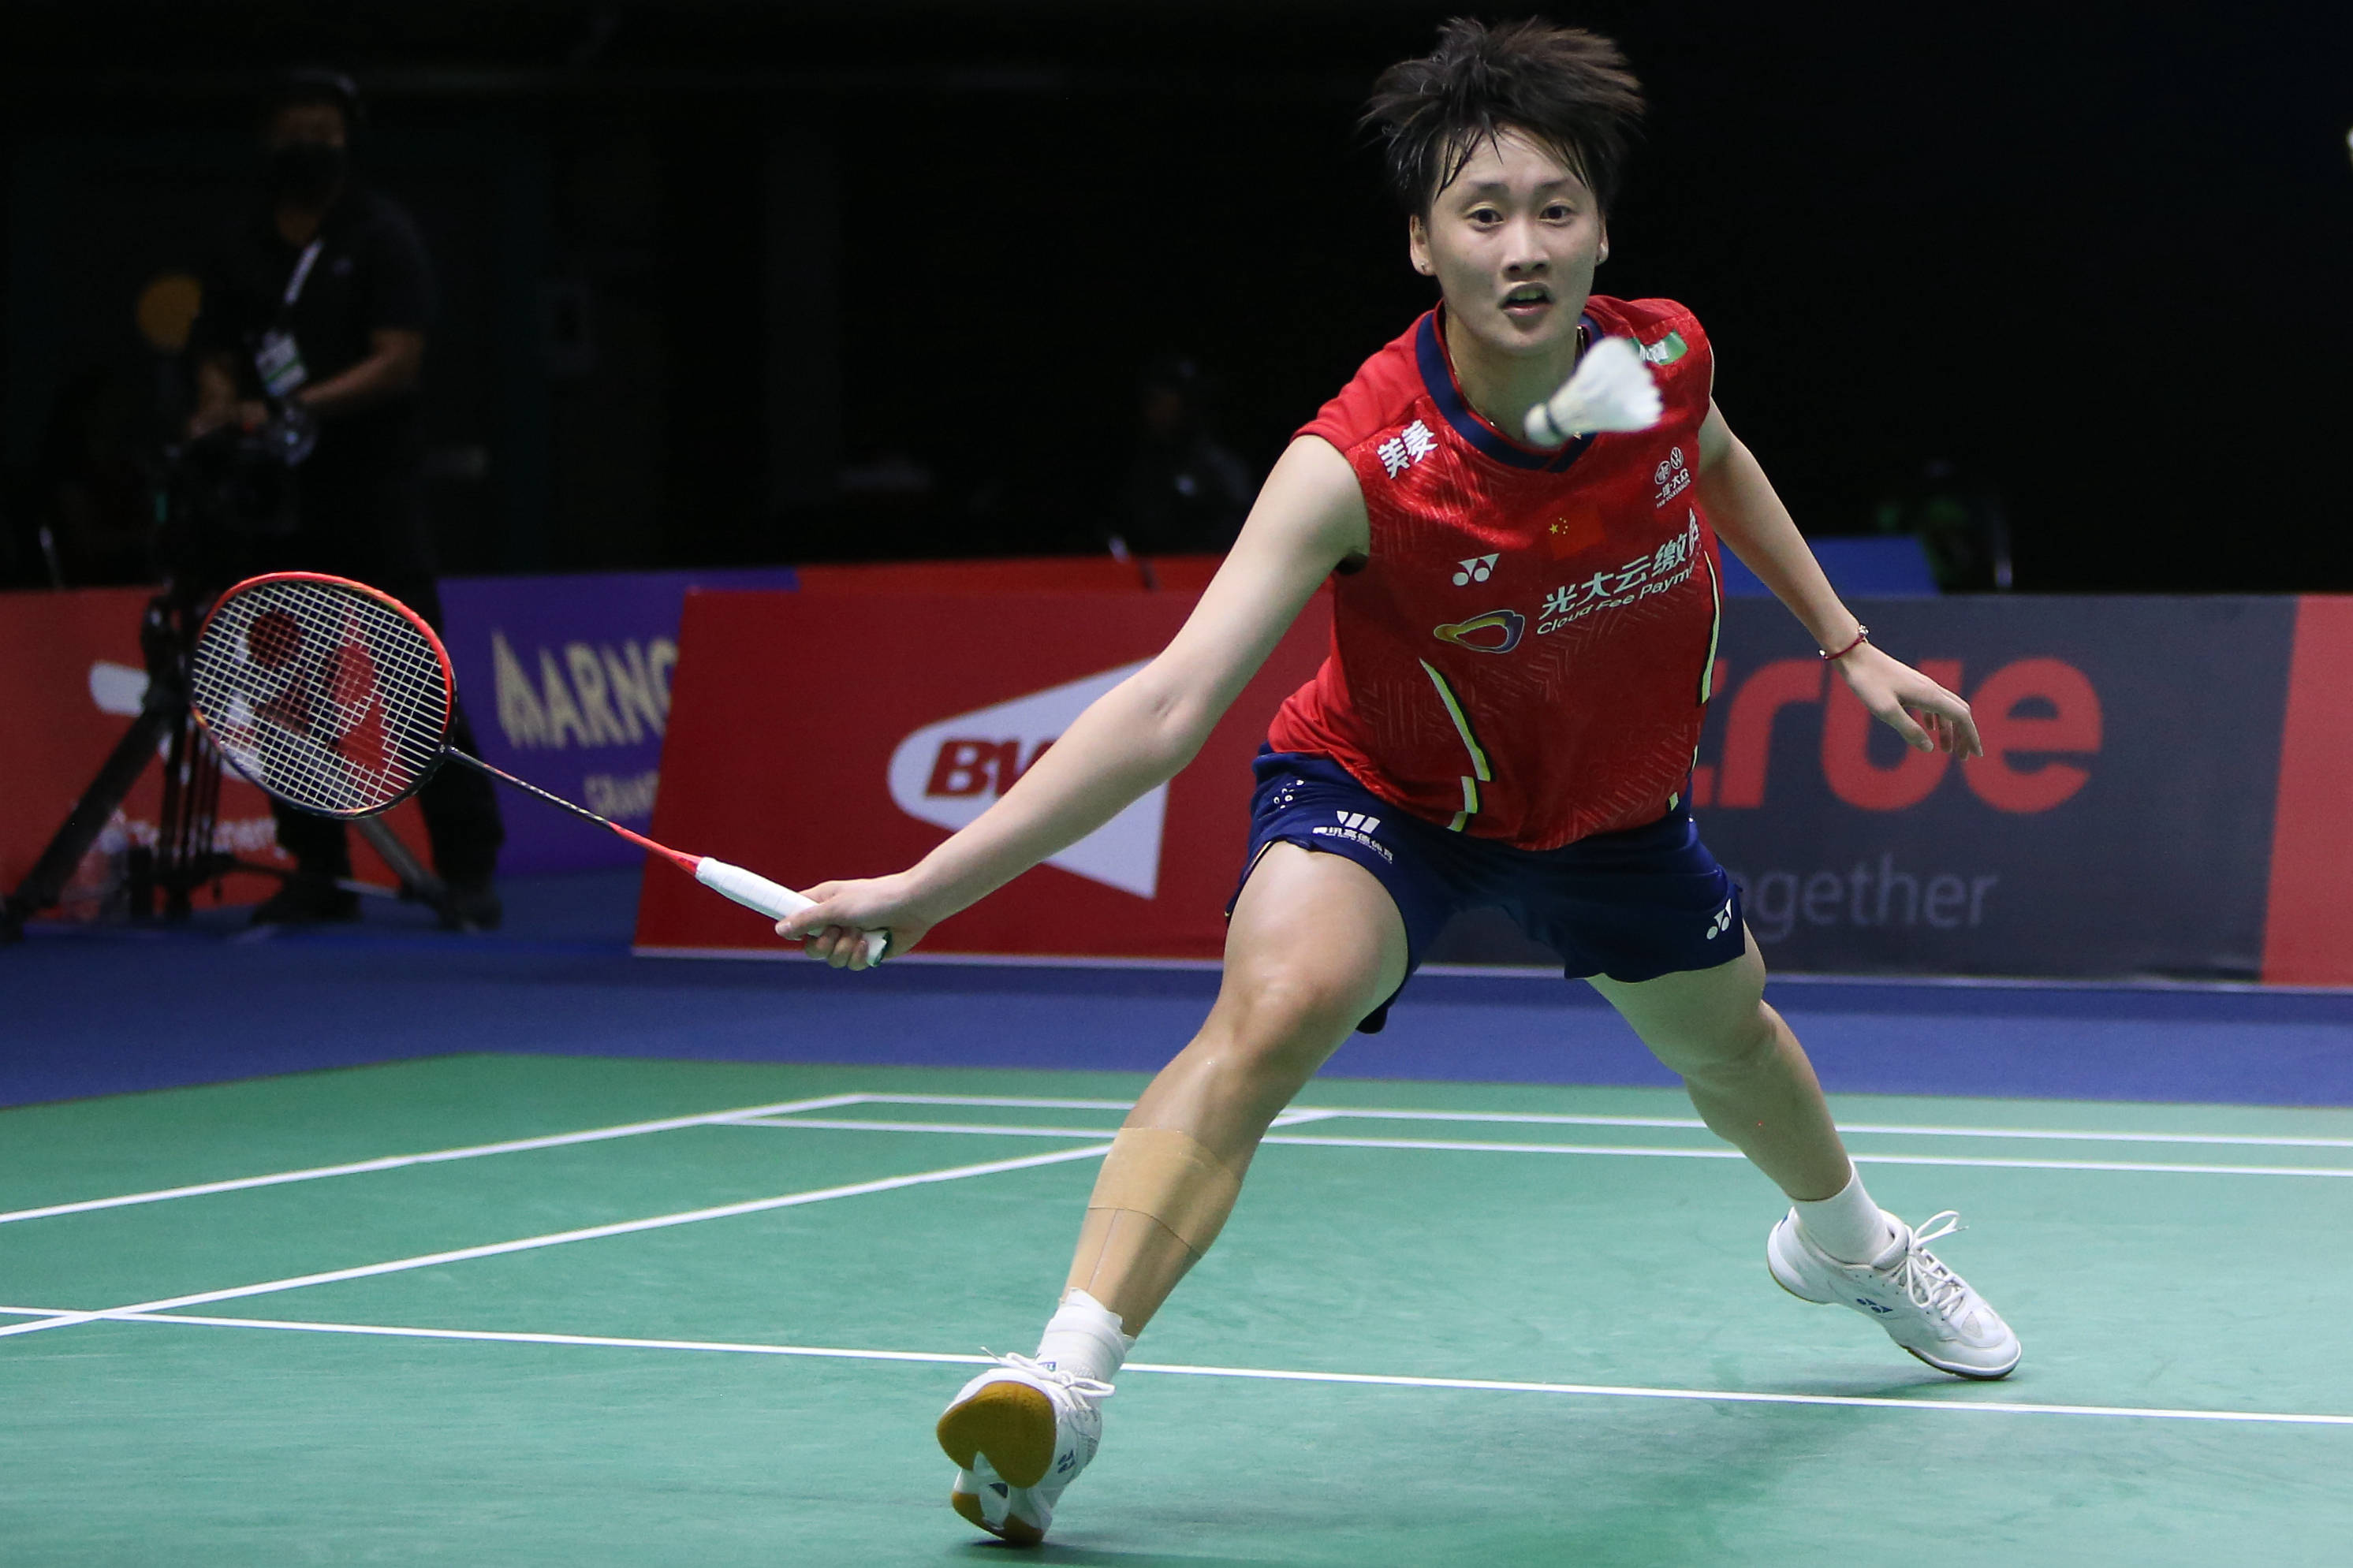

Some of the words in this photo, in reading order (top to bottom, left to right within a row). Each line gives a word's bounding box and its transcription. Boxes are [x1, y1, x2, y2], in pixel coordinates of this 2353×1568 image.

[1537, 603, 1594, 635] Cloud
[1596, 594, 1635, 611] Fee
[1639, 561, 1695, 600] Paym
